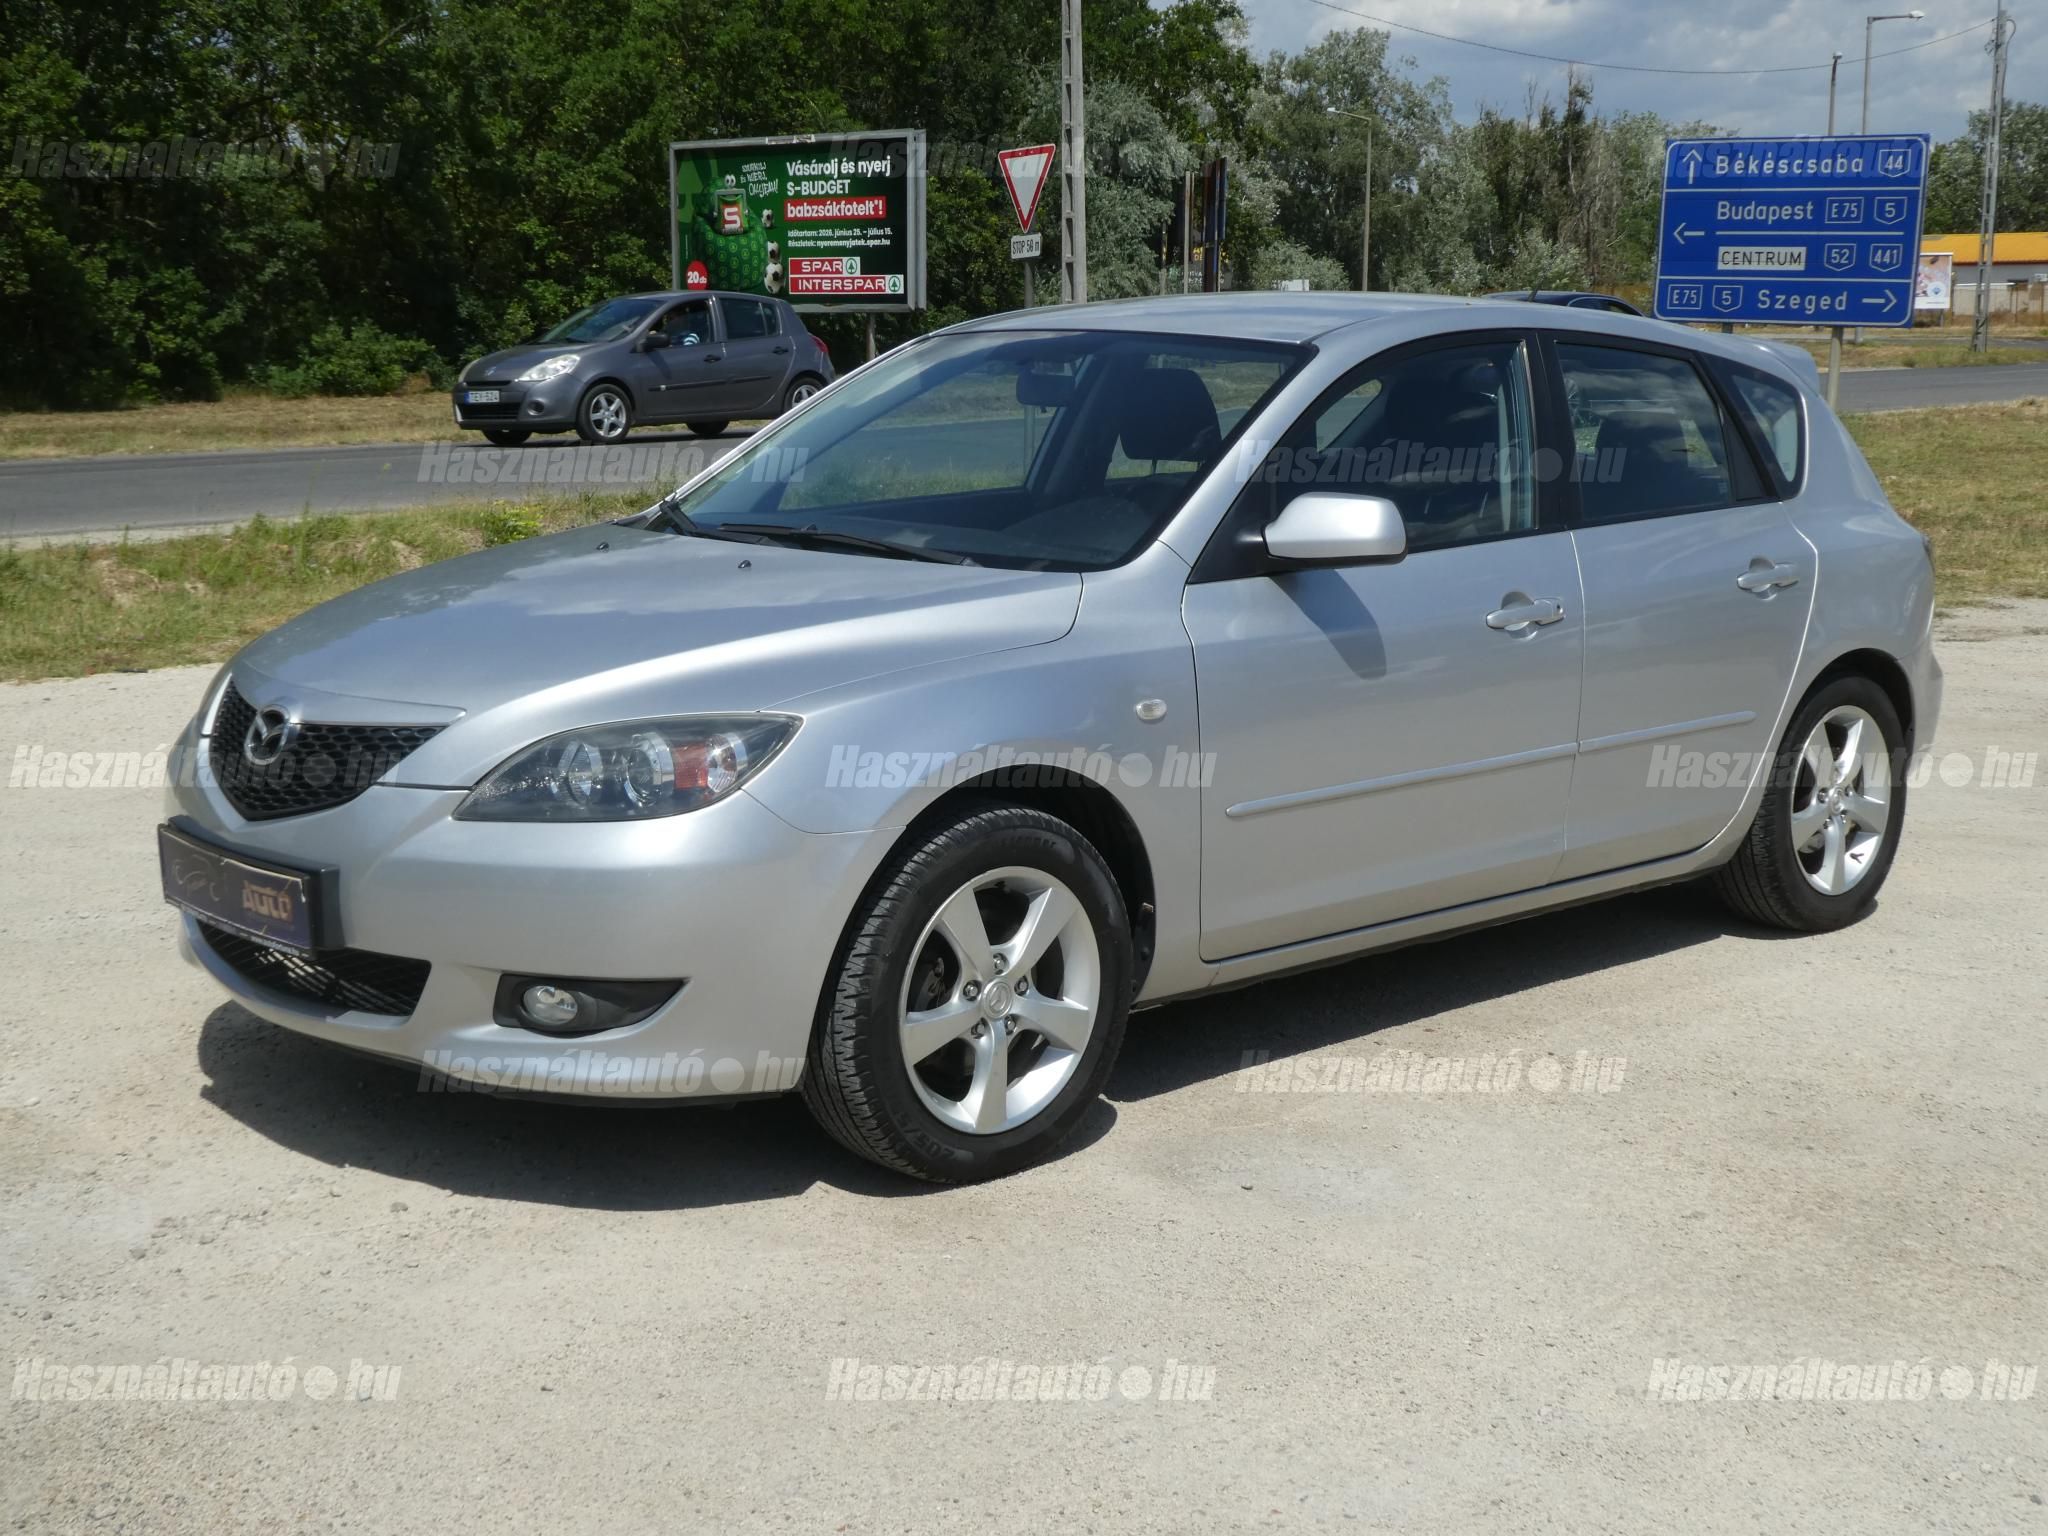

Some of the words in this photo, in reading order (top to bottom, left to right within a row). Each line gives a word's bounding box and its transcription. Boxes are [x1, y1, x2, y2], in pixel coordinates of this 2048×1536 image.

[786, 158, 839, 179] Vásárolj
[841, 157, 855, 174] és
[858, 155, 891, 178] nyerj
[1715, 152, 1864, 174] Békéscsaba
[1885, 155, 1904, 170] 44
[786, 179, 851, 196] S-BUDGET
[1717, 201, 1814, 225] Budapest
[1884, 202, 1896, 218] 5
[1012, 240, 1025, 255] STOP
[1721, 251, 1803, 266] CENTRUM
[1831, 249, 1849, 264] 52
[1873, 248, 1898, 264] 441
[801, 260, 842, 273] SPAR
[798, 278, 886, 291] INTERSPAR
[1722, 290, 1732, 304] 5
[1757, 289, 1848, 314] Szeged
